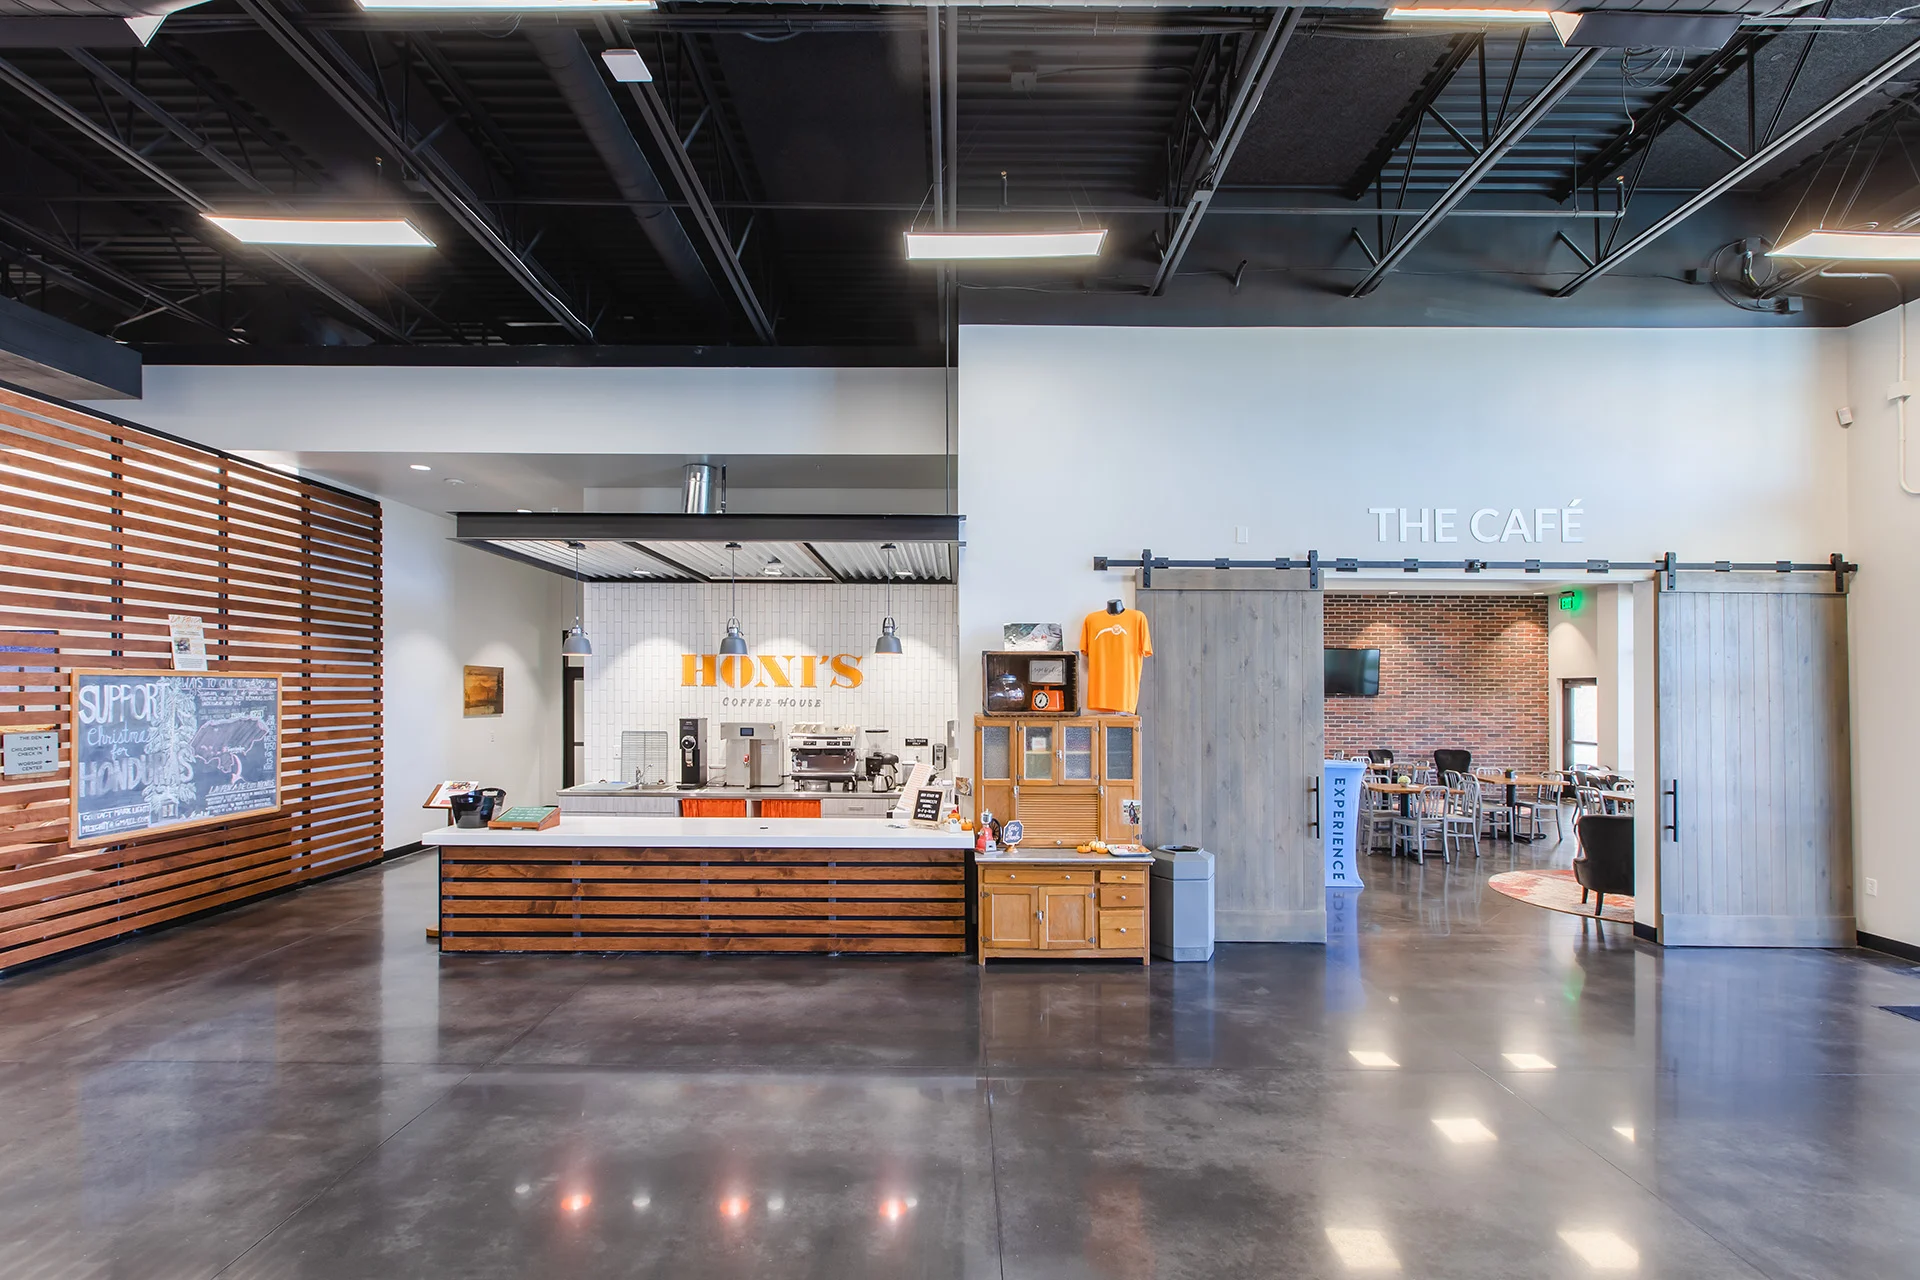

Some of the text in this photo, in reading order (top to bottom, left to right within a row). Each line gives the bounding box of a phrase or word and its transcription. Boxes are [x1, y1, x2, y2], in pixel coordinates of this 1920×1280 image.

[1368, 498, 1586, 544] THE CAFÉ
[206, 678, 217, 688] TO
[681, 653, 864, 689] HONI'S
[79, 683, 170, 724] SUPPORT
[722, 697, 822, 708] COFFEE HOUSE
[1332, 778, 1346, 880] EXPERIENCE
